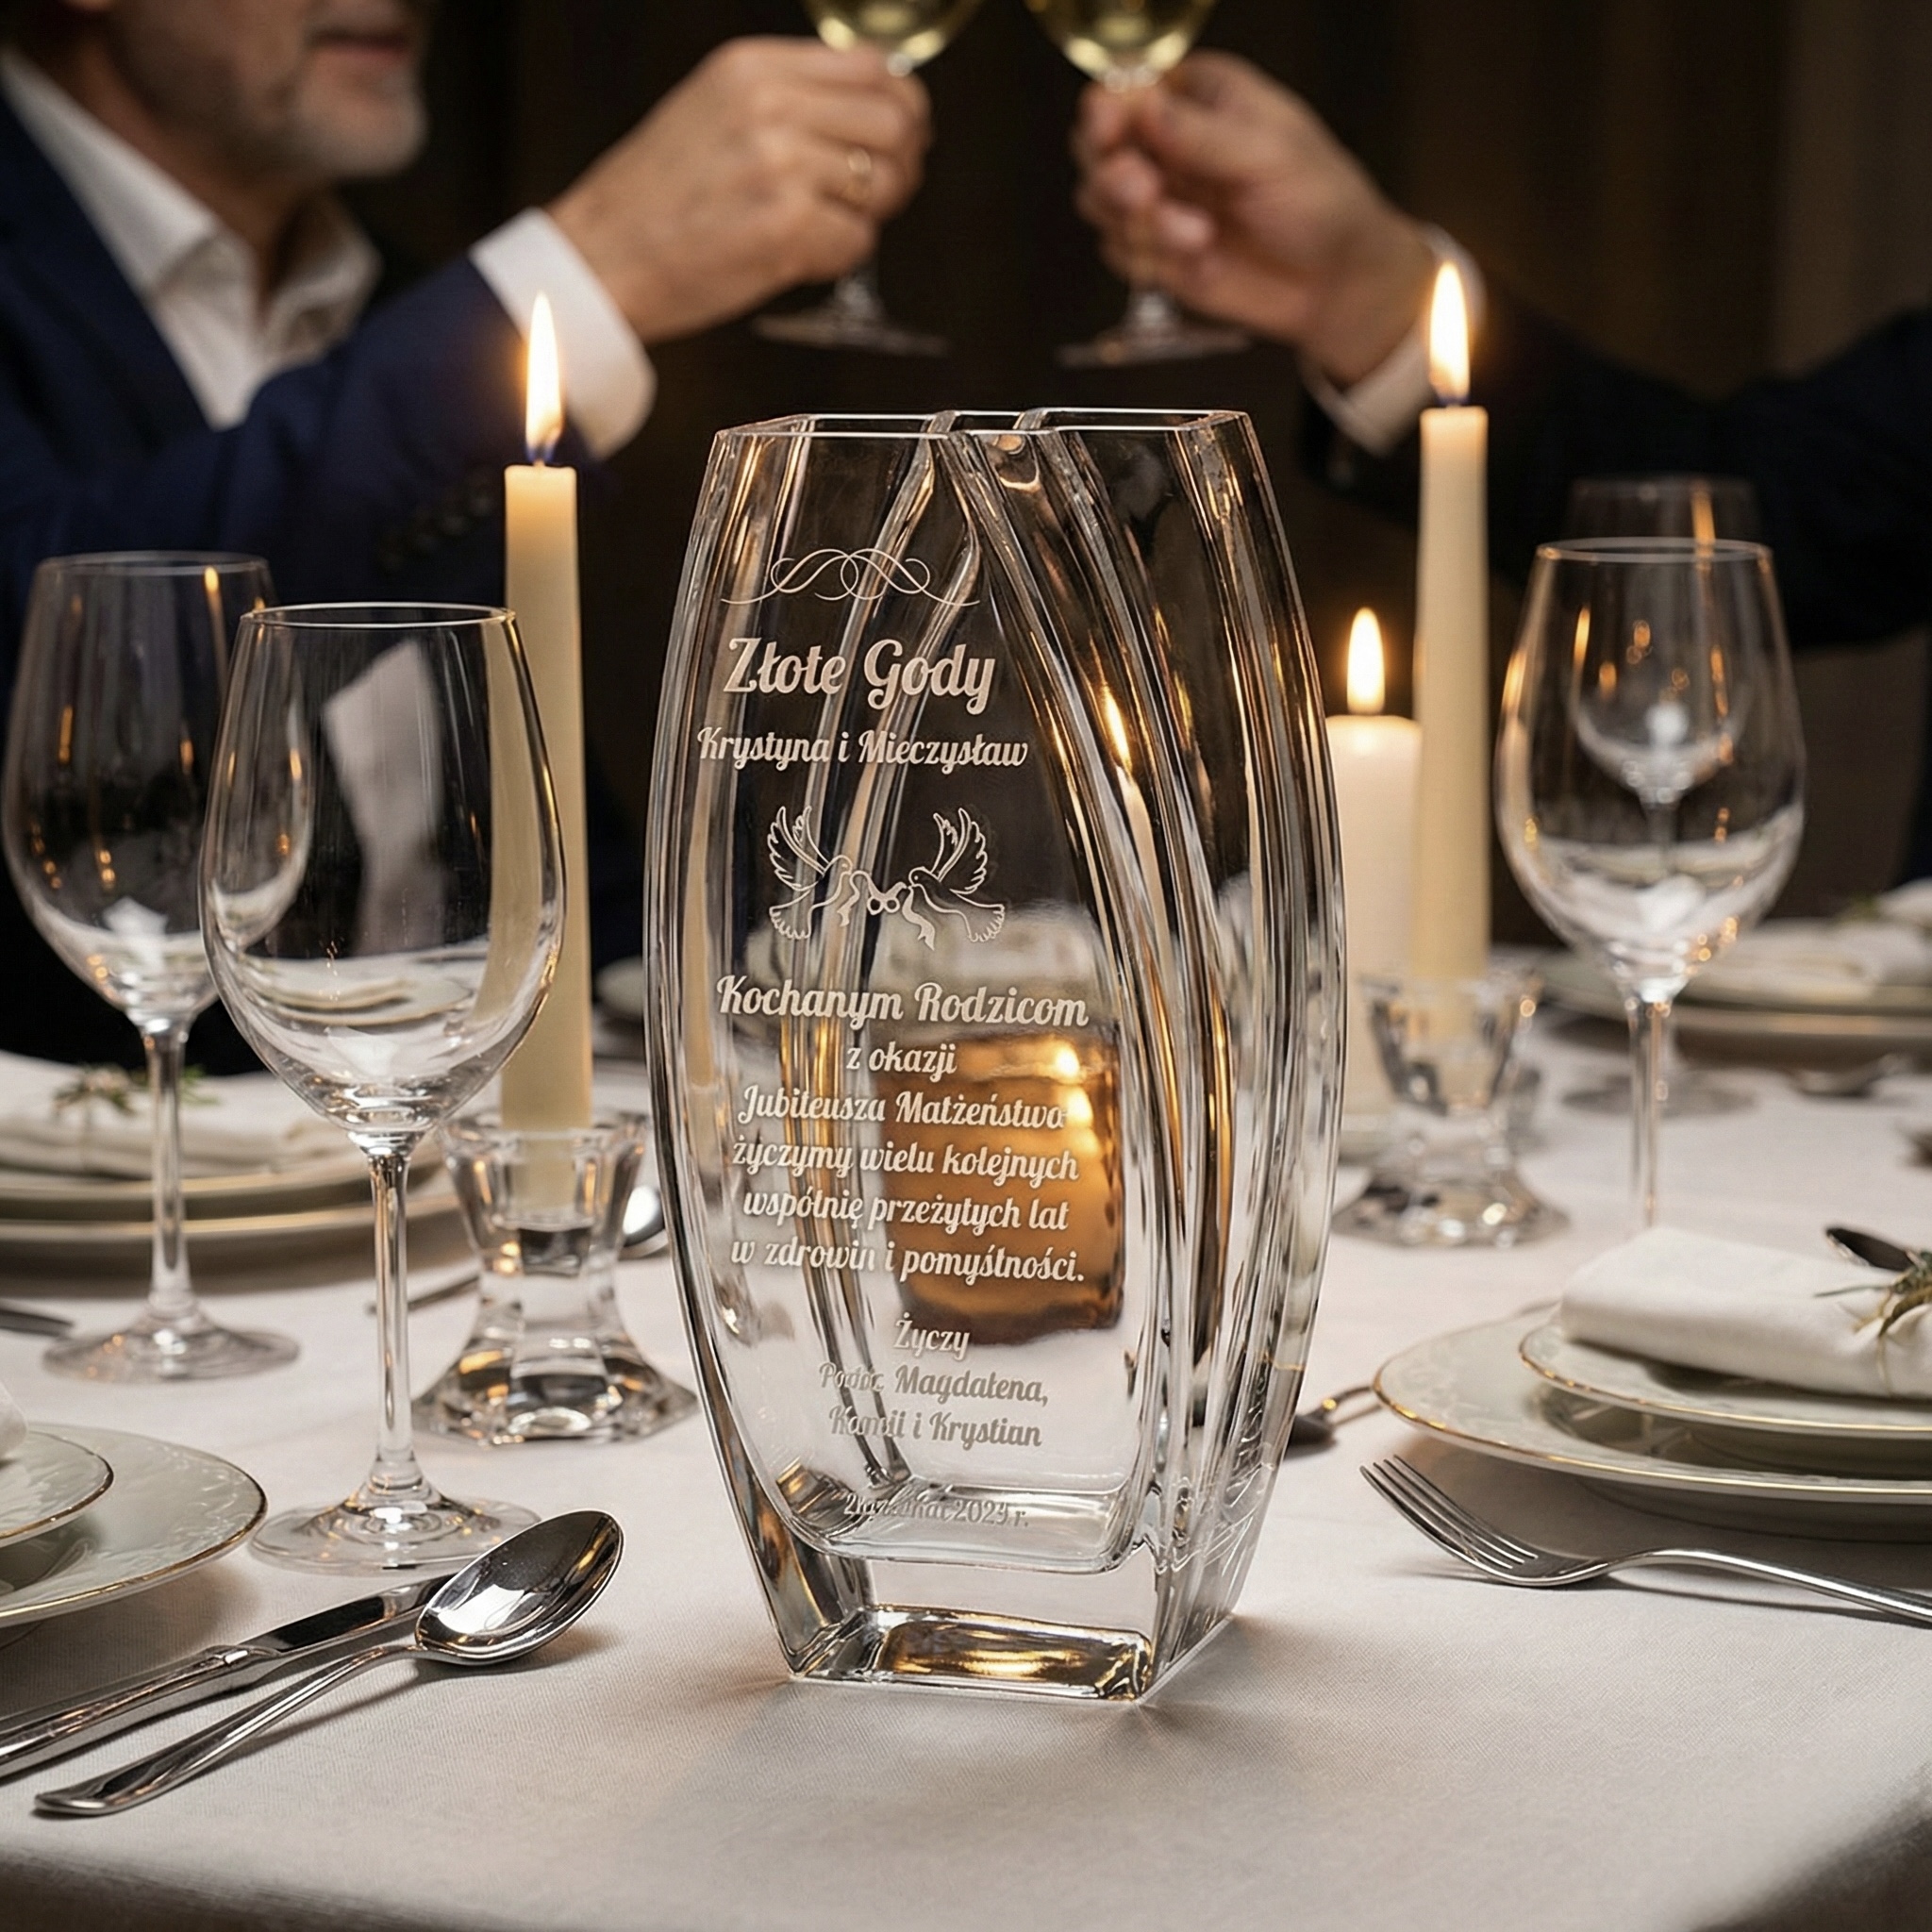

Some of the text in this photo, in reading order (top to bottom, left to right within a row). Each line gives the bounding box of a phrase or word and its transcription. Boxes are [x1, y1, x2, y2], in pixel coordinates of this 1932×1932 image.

[724, 637, 996, 715] Złote Gody
[697, 726, 1029, 775] Krystyna i Mieczysław
[716, 974, 1090, 1031] Kochanym Rodzicom
[846, 1041, 958, 1083] z okazji
[732, 1135, 1079, 1189] życzymy wielu kolejnych
[867, 1193, 1021, 1237] przeżytych
[1028, 1198, 1070, 1230] lat
[730, 1241, 755, 1264] w
[884, 1241, 896, 1272] i
[892, 1312, 971, 1361] Życzy
[913, 1412, 923, 1440] i
[929, 1411, 1042, 1451] Krystian
